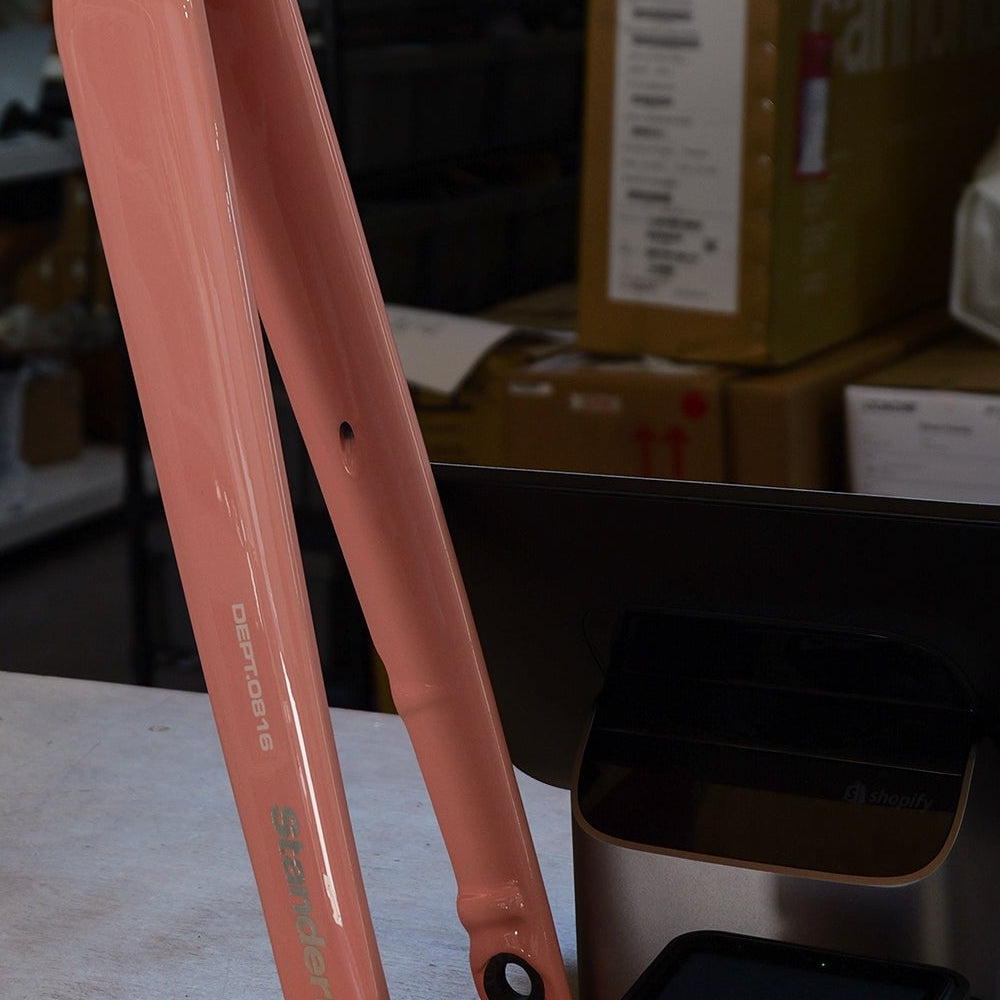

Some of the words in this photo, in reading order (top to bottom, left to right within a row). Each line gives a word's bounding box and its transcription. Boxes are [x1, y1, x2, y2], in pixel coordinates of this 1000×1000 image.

[231, 602, 274, 753] DEPT.0816
[867, 789, 934, 812] shopify
[270, 803, 335, 1000] Stander
